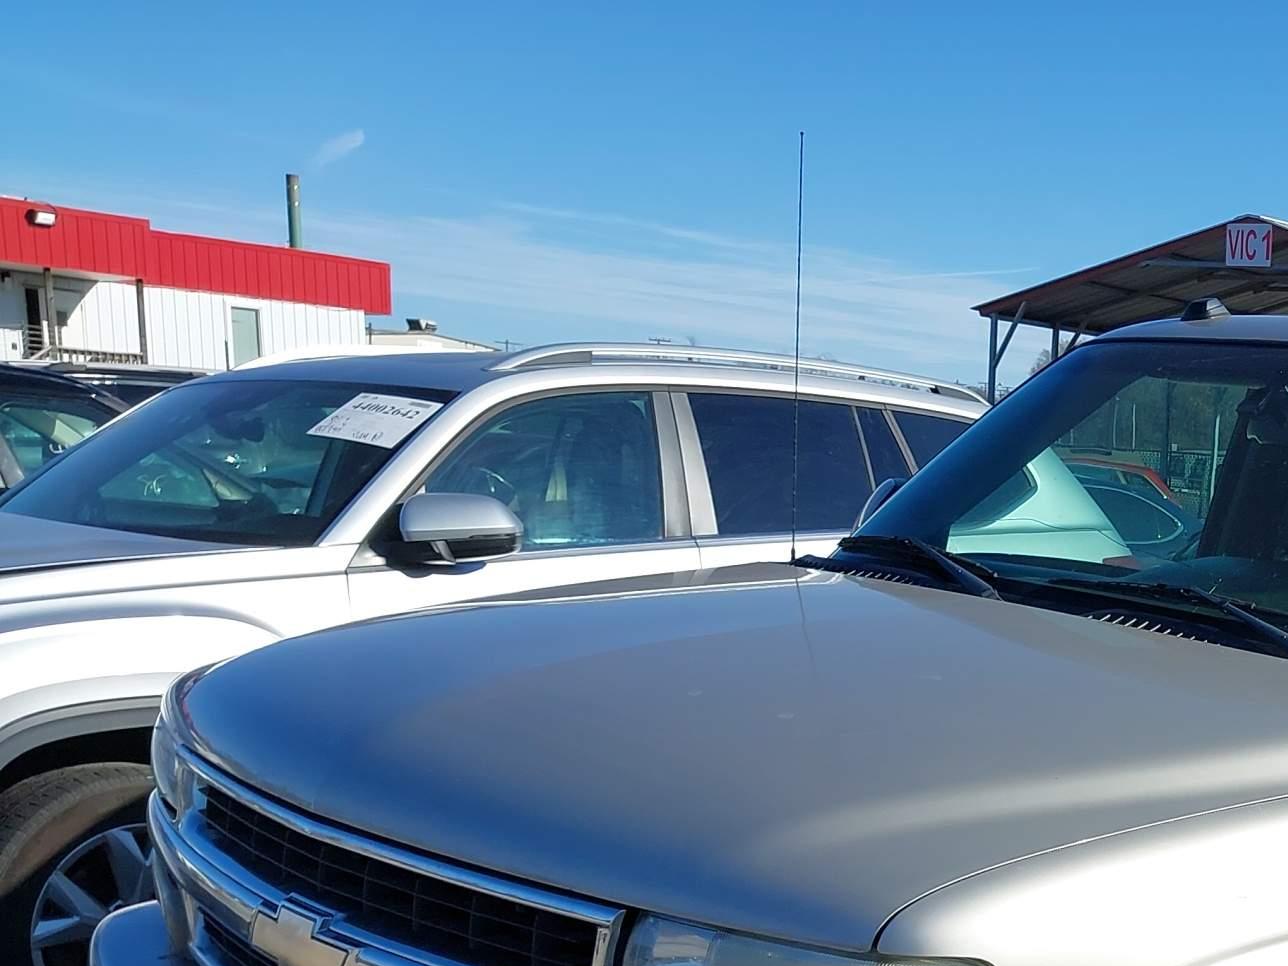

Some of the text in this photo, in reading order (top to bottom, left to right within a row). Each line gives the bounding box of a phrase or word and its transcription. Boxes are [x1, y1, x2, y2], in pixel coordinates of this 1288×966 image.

[1228, 229, 1271, 261] VIC 1
[352, 401, 421, 420] 44002642
